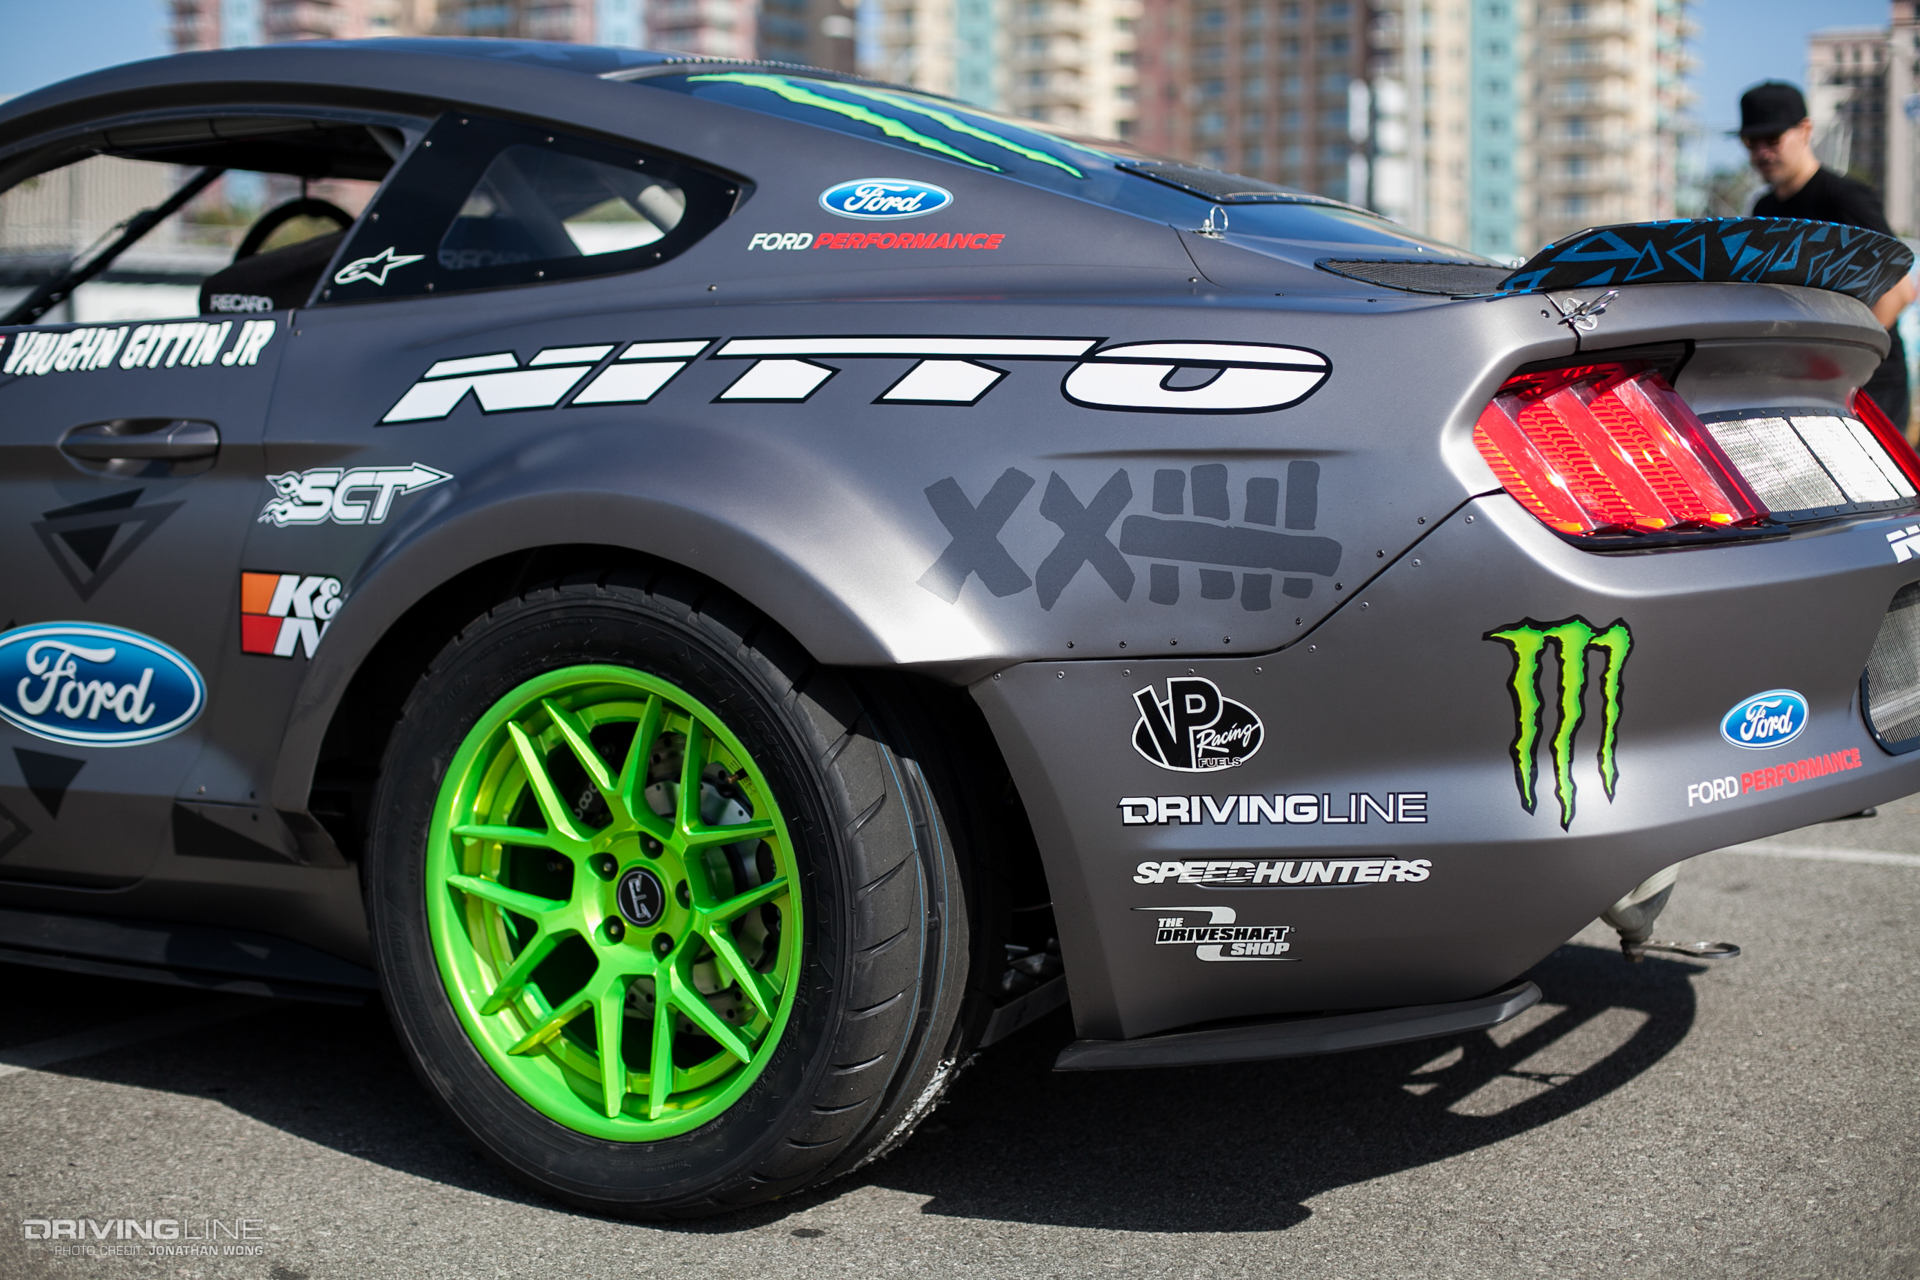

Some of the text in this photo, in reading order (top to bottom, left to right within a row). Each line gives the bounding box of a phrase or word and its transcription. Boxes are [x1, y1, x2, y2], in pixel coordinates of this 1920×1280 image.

[844, 183, 927, 212] Ford
[748, 232, 1005, 251] FORD PERFORMANCE
[210, 294, 273, 313] RECARO
[3, 319, 276, 375] VAUGHN GITTIN JR
[377, 337, 1333, 425] NITTO
[288, 464, 428, 526] SCT
[16, 640, 155, 724] Ford
[1132, 676, 1223, 770] VP
[1740, 699, 1794, 741] Ford
[1196, 722, 1261, 757] Racing
[1198, 757, 1243, 768] FUELS
[1687, 747, 1862, 807] FORD PERFORMANCE
[1132, 859, 1433, 884] SPEEDHUNTERS
[1156, 926, 1290, 945] DRIVESHAFT
[1157, 917, 1184, 928] THE
[1230, 942, 1290, 956] SHOP
